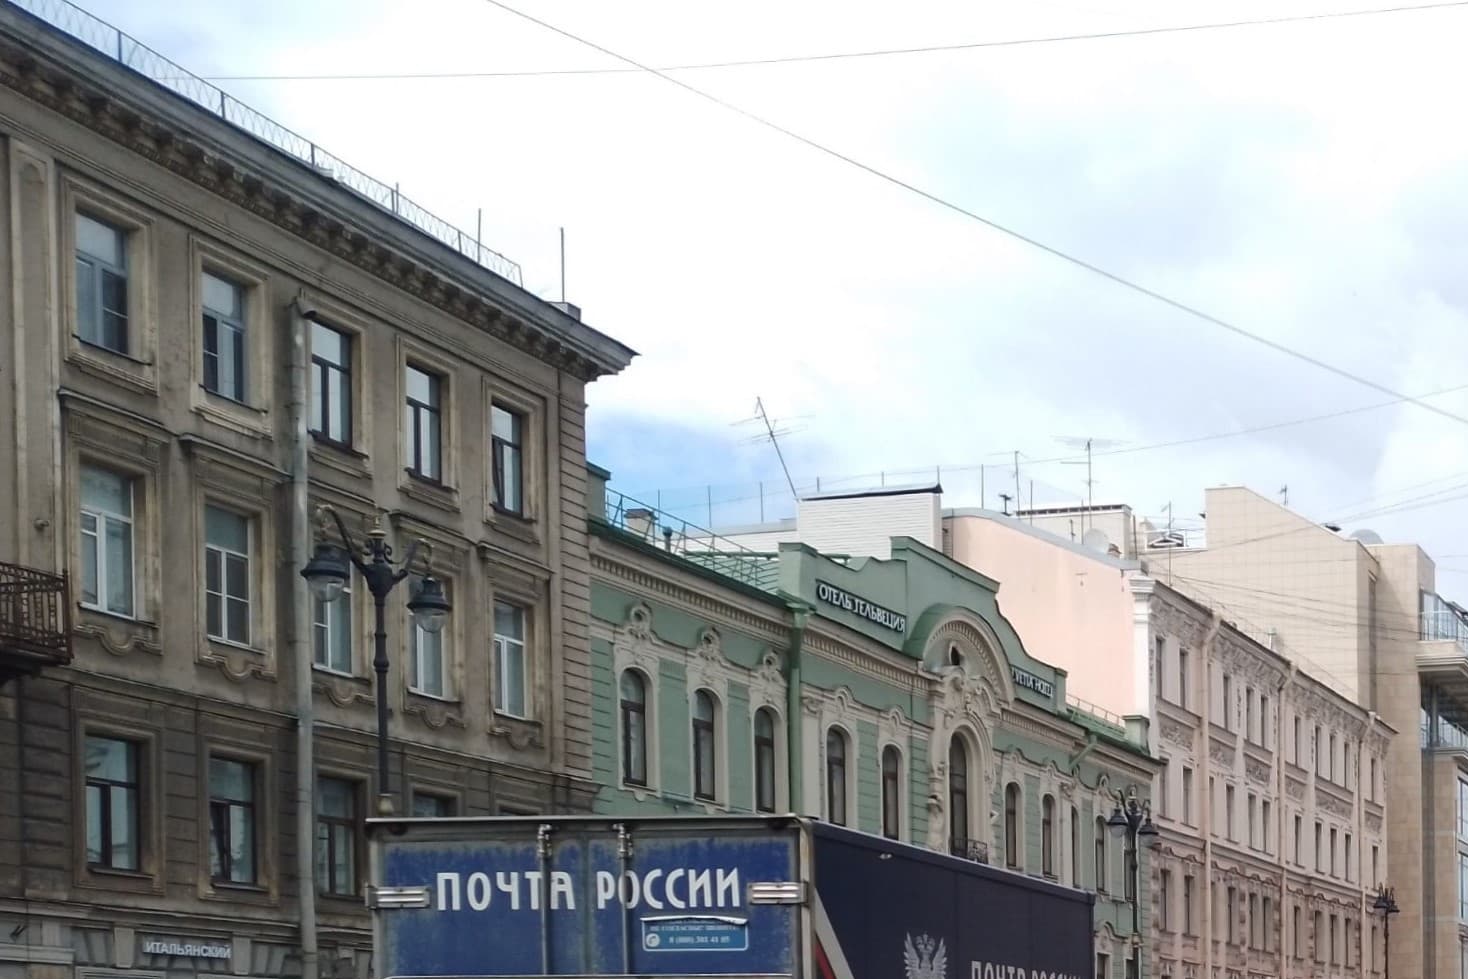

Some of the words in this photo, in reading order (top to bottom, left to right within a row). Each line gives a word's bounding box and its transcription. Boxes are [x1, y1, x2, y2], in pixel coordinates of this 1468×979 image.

[819, 584, 852, 610] ОТЕЛЬ
[436, 871, 575, 911] ПОЧТА
[596, 867, 741, 910] РОССИИ
